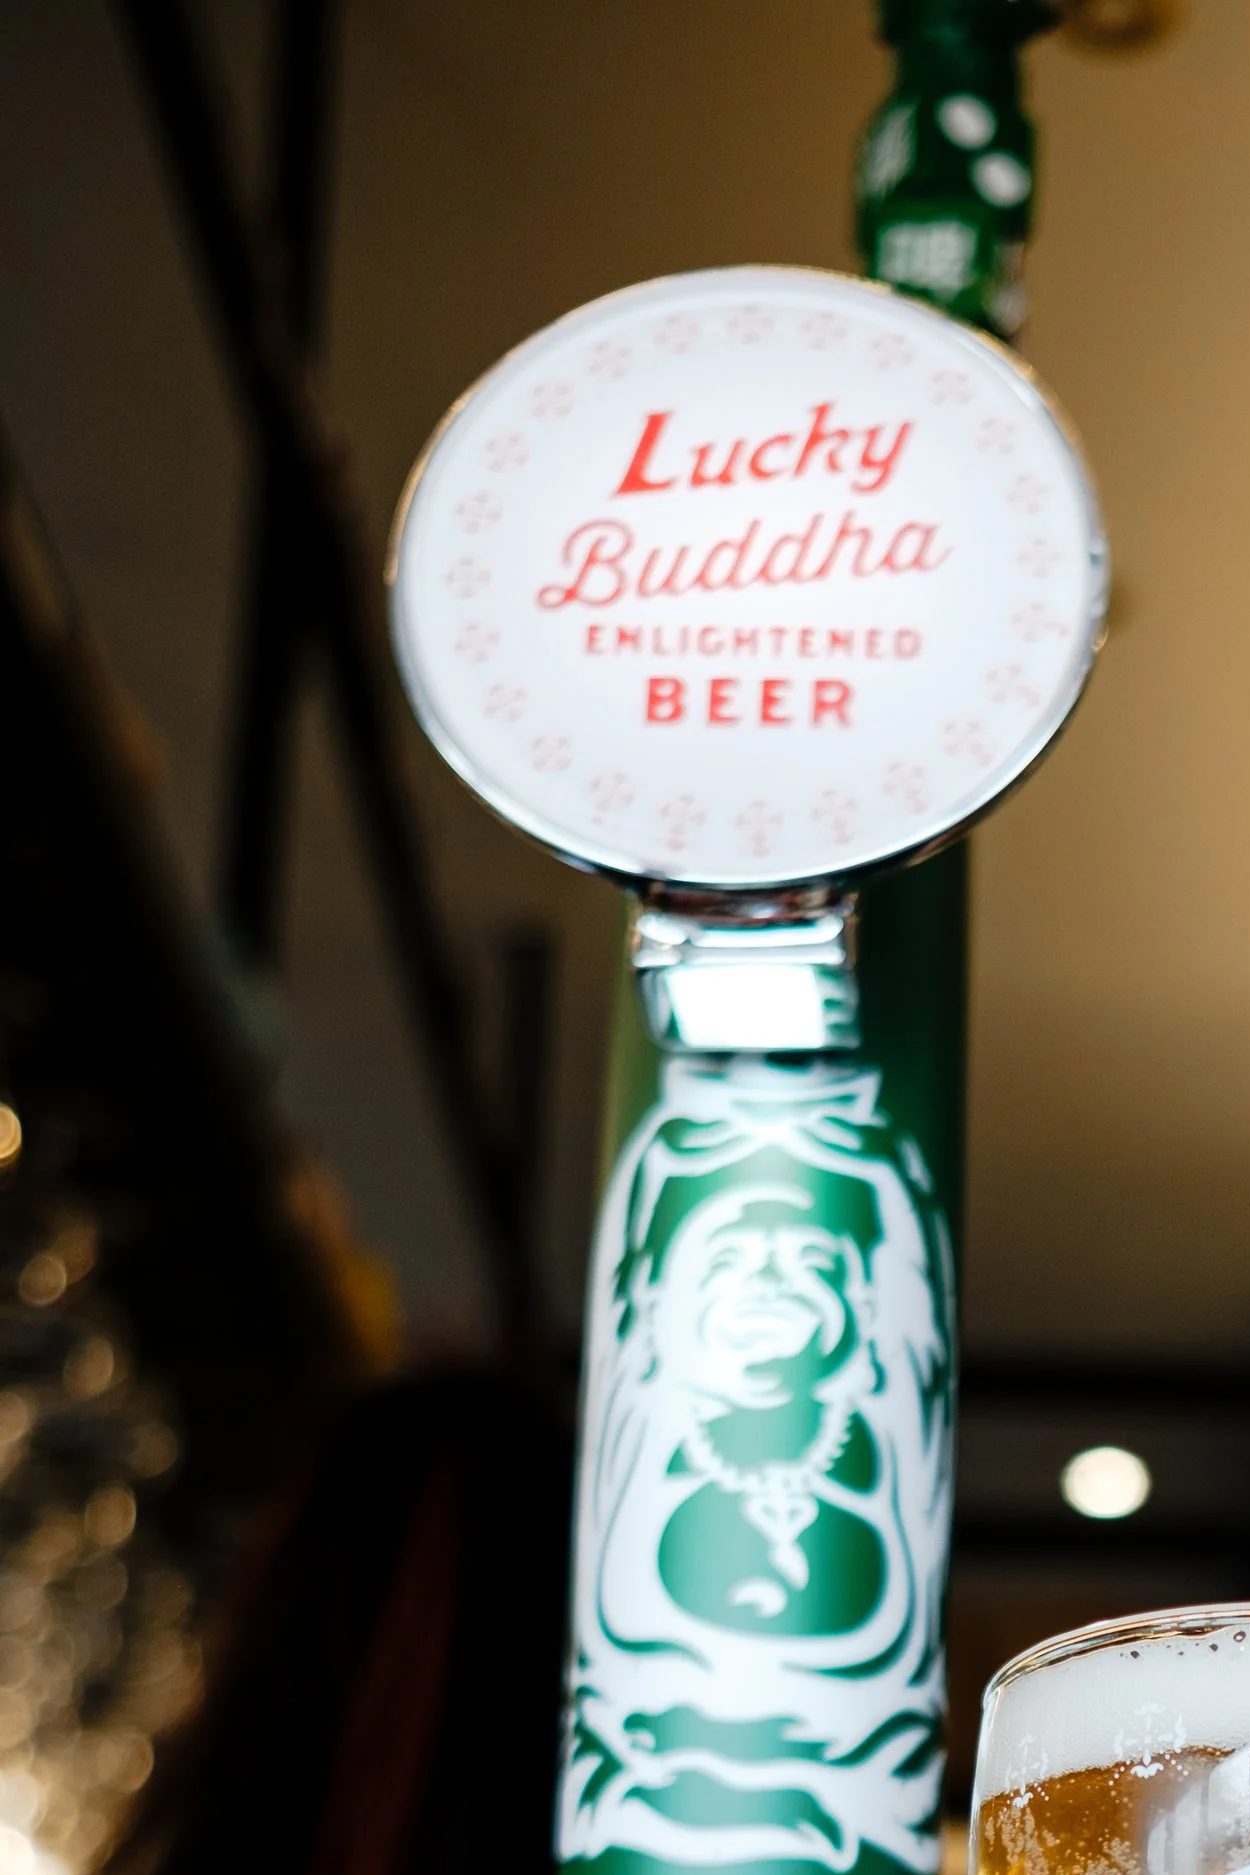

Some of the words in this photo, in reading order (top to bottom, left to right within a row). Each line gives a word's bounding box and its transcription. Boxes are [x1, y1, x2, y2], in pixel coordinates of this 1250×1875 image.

[609, 402, 914, 497] Lucky
[535, 509, 953, 611] Buddha
[584, 624, 922, 661] ENLIGHTENED
[644, 675, 854, 728] BEER
